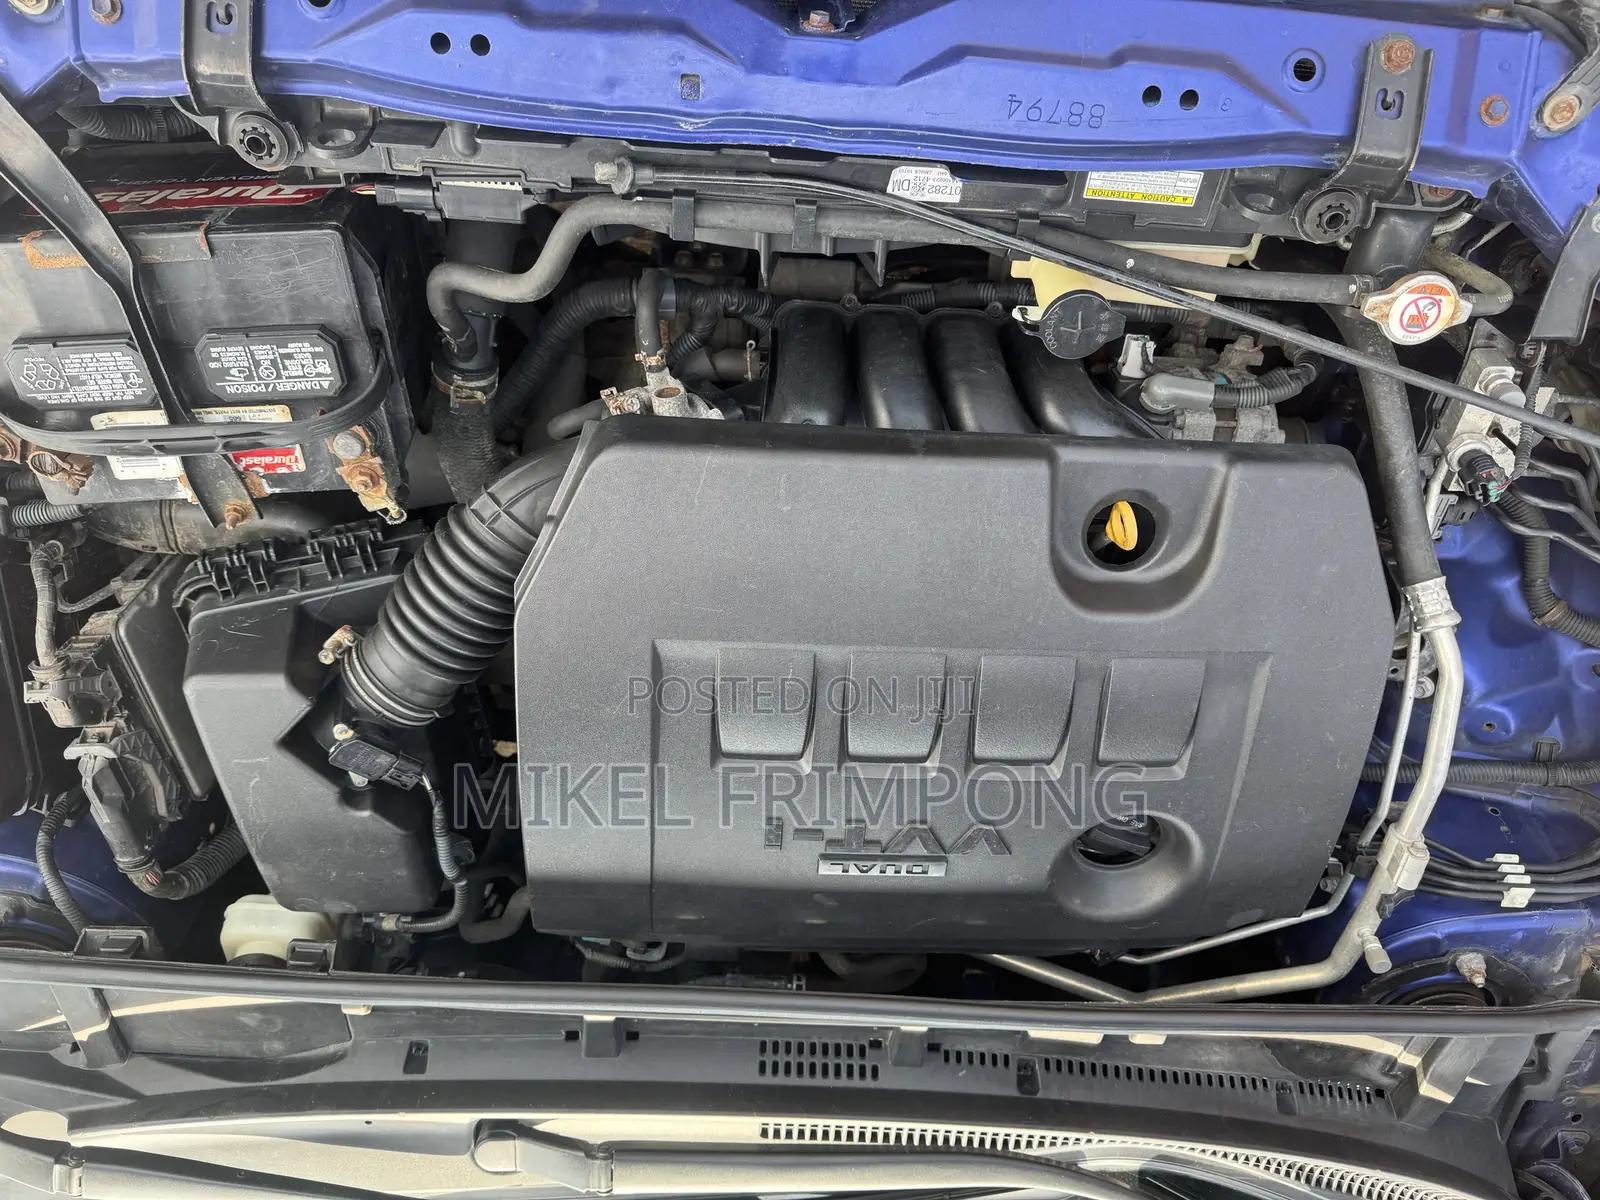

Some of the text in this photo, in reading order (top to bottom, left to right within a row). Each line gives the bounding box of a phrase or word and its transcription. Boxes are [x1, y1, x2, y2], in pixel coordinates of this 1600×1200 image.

[1008, 94, 1105, 128] 88794
[1220, 98, 1232, 111] 3
[95, 184, 305, 204] Duralas
[1091, 190, 1176, 202] CAUTION ATTENTION
[1045, 306, 1064, 349] COOLANT
[225, 384, 266, 394] POISON
[275, 381, 320, 391] DANGER
[240, 455, 296, 467] Duralast
[830, 863, 930, 876] DUAL
